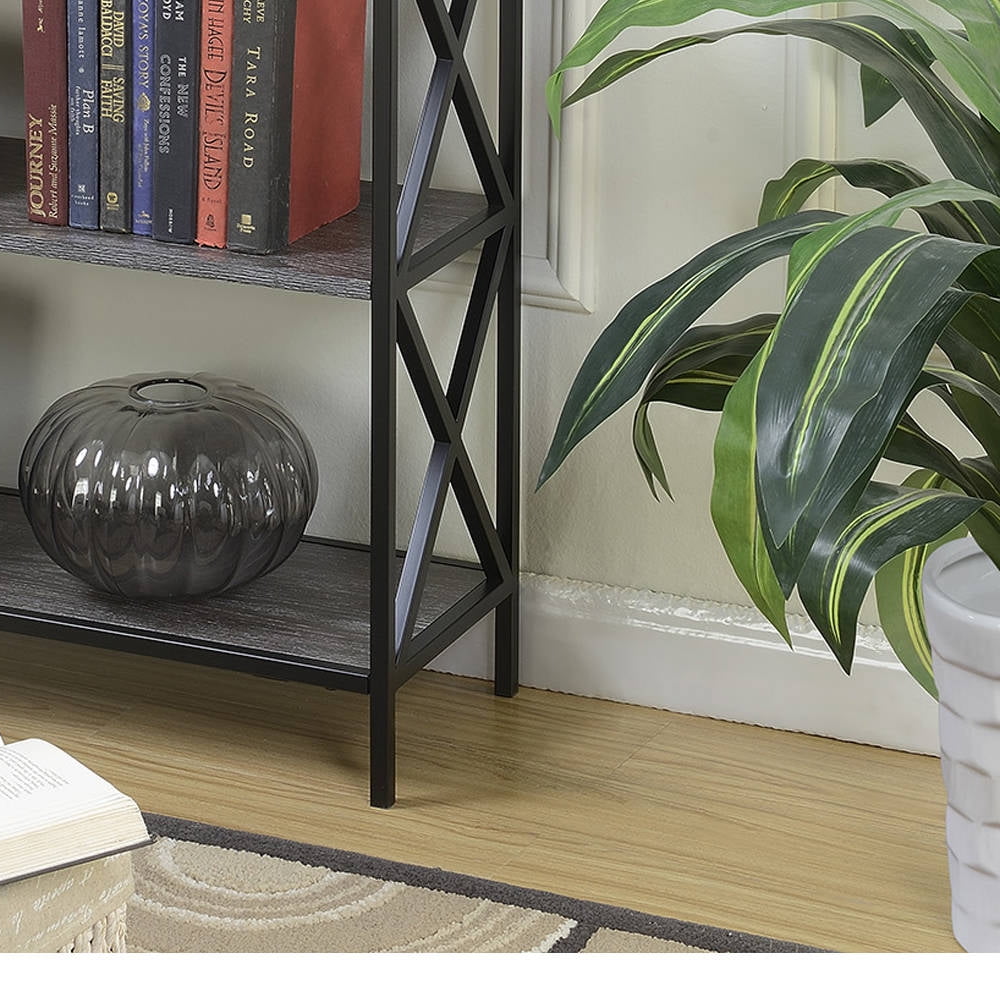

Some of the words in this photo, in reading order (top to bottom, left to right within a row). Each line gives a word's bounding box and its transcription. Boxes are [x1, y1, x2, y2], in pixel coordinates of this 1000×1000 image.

[78, 27, 86, 58] lamott
[101, 0, 113, 57] BALDACCI
[113, 11, 124, 47] DAVID
[207, 18, 223, 62] HAGEE
[138, 45, 150, 89] STORY
[178, 56, 187, 77] THE
[246, 46, 261, 98] TARA
[82, 89, 95, 118] Plan
[100, 80, 113, 119] FAITH
[112, 76, 125, 124] SAVING
[159, 54, 171, 154] CONFESSIONS
[177, 84, 189, 118] NEW
[82, 123, 95, 133] B
[243, 111, 259, 168] ROAD
[28, 113, 46, 218] JOURNEY
[48, 189, 58, 219] Robert
